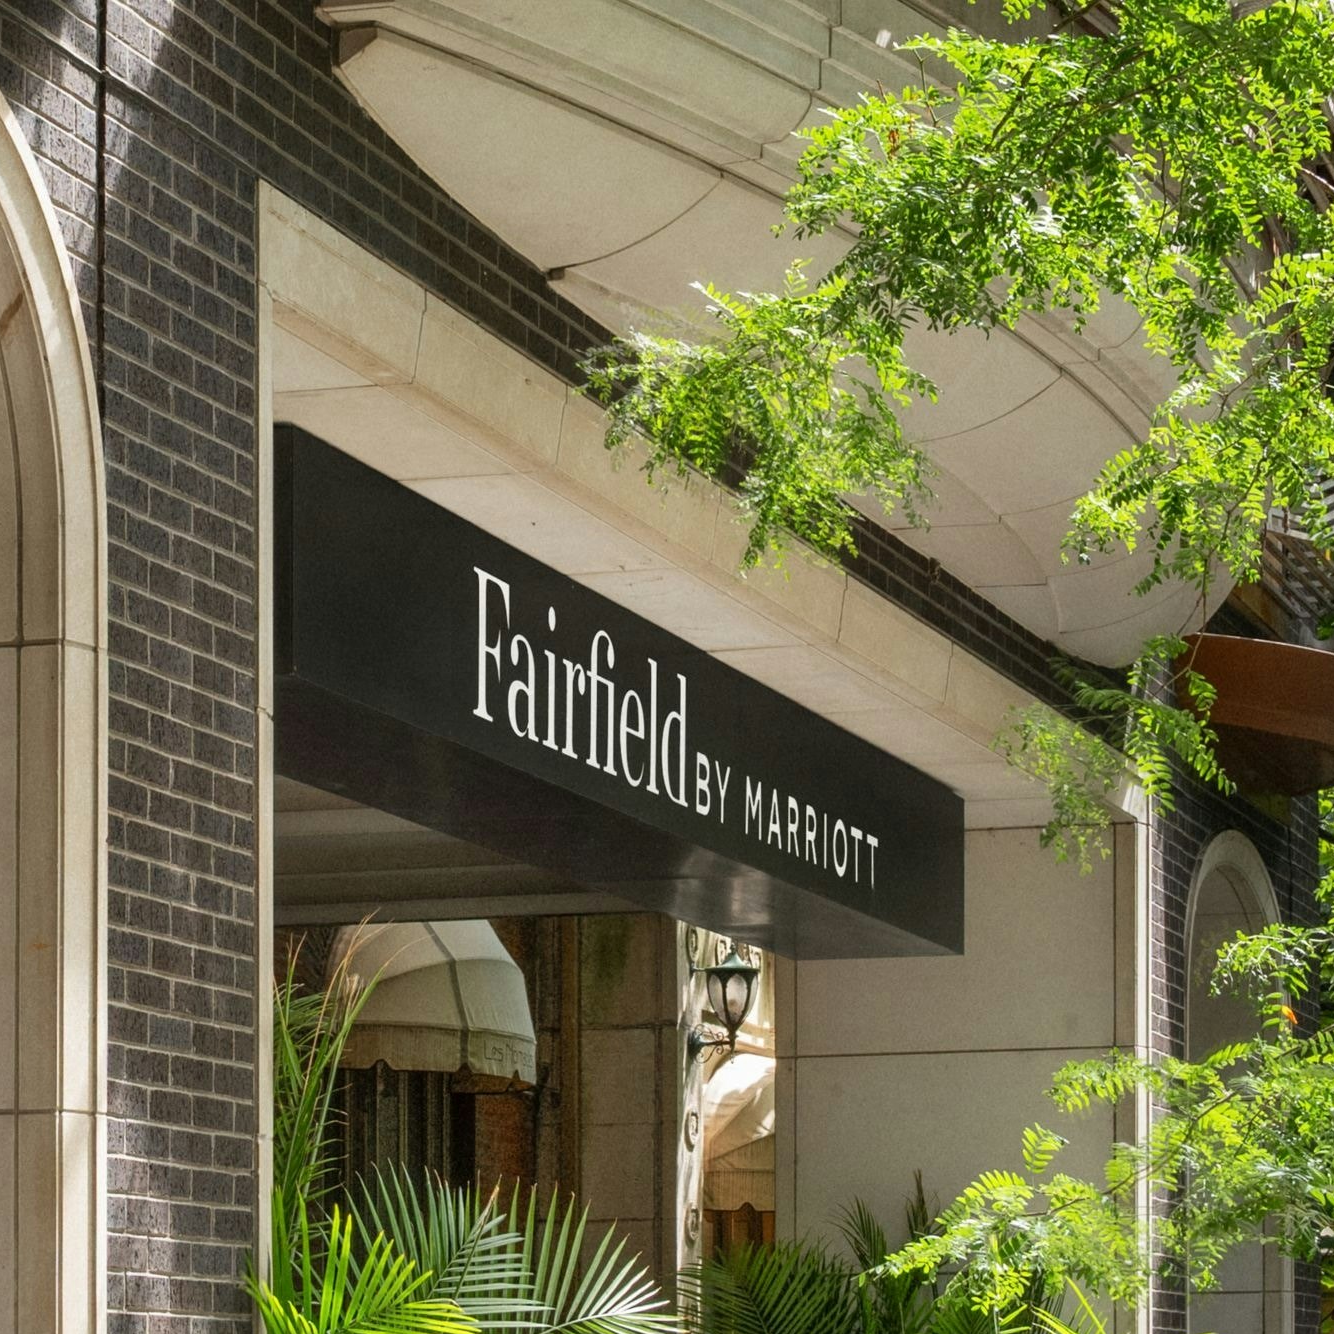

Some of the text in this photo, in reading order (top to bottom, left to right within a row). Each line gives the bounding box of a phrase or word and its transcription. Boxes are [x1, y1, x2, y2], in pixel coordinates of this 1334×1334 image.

[473, 566, 879, 889] Fairfield BY MARRIOTT
